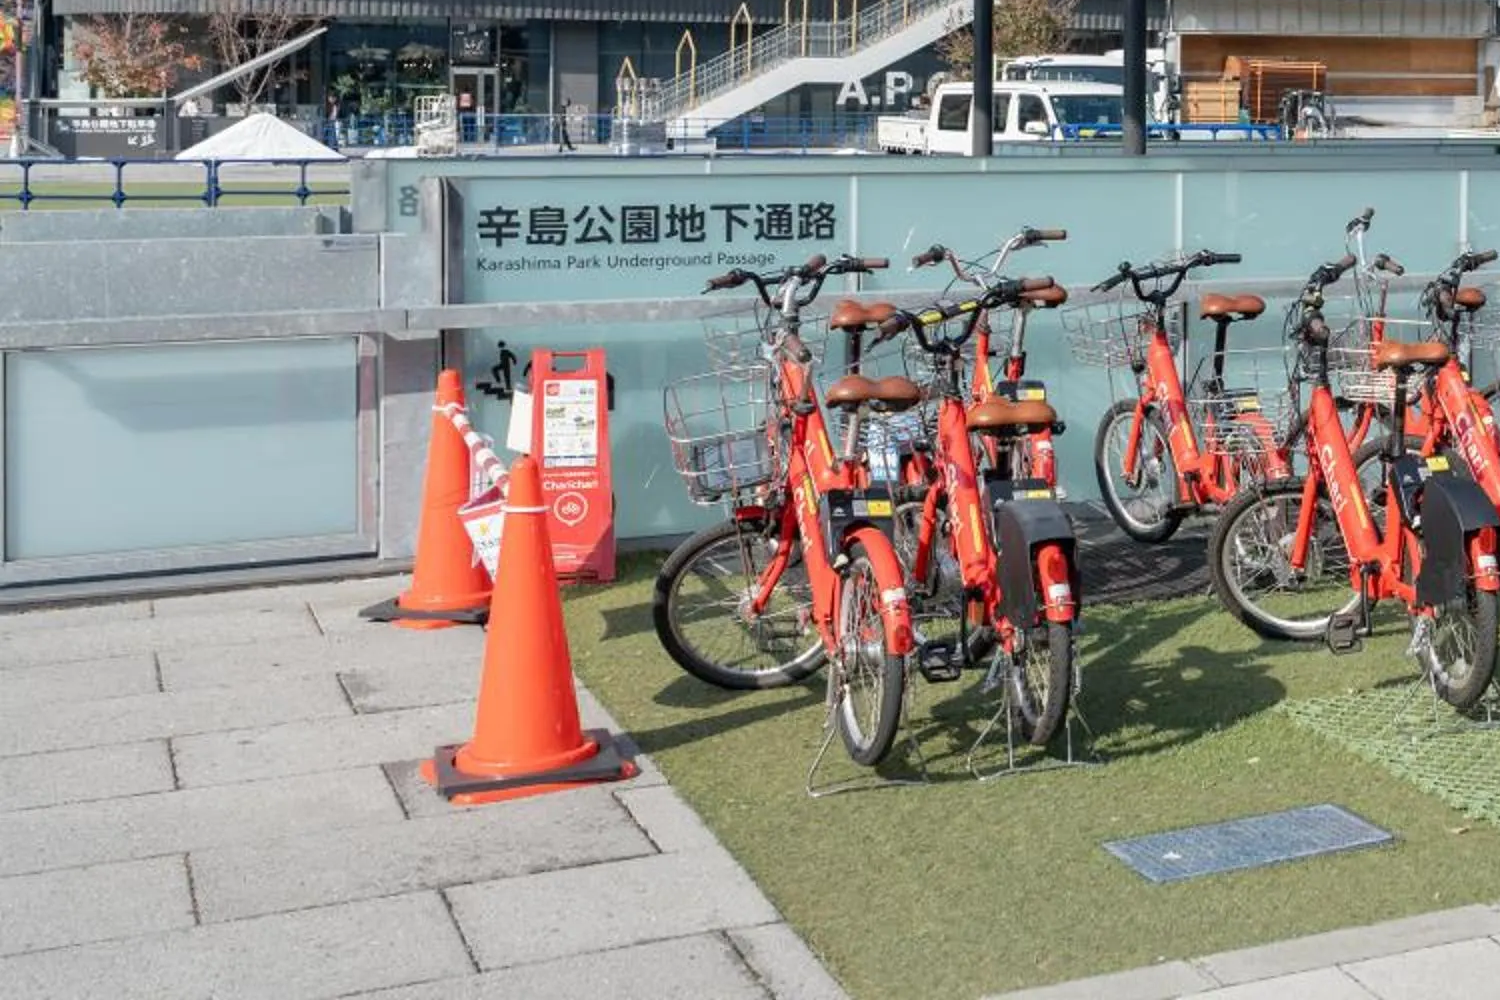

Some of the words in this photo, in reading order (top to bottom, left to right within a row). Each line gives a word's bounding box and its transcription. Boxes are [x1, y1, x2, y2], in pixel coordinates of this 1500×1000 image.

[477, 203, 837, 247] 辛島公園地下通路
[477, 256, 561, 272] Karashima
[567, 254, 600, 270] Park
[607, 252, 712, 271] Underground
[717, 251, 775, 269] Passage
[1455, 411, 1490, 475] Chari
[1322, 444, 1348, 514] Chari
